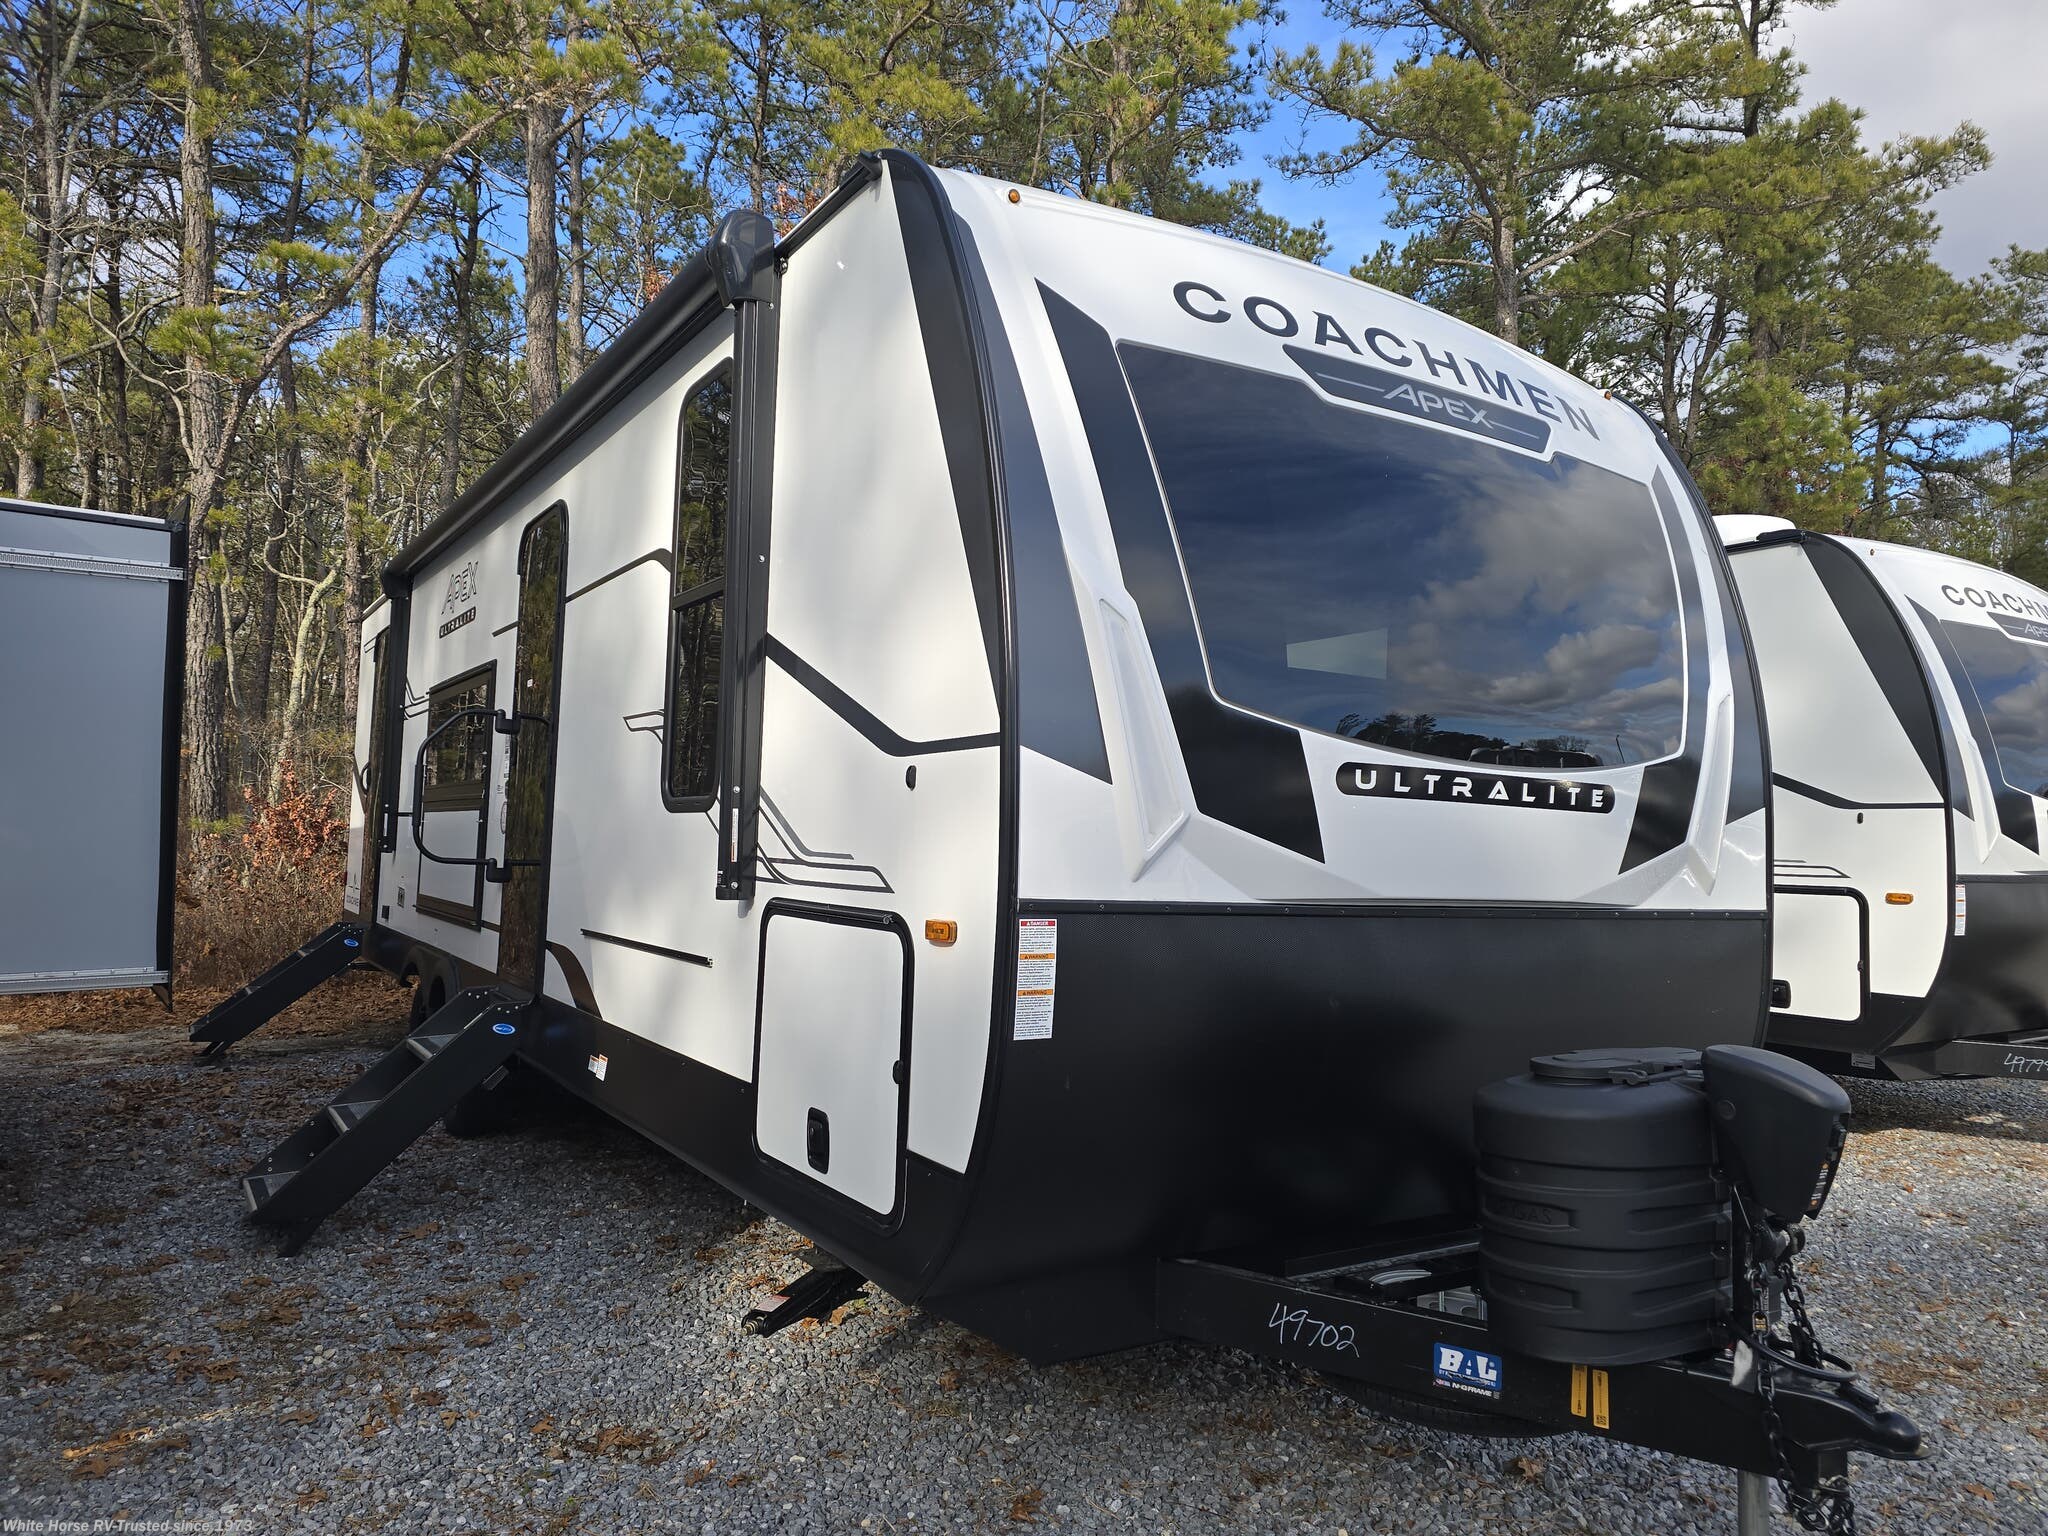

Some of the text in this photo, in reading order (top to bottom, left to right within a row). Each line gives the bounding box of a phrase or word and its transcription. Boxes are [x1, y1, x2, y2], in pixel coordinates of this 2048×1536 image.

[1173, 280, 1601, 441] COACHMEN
[1383, 383, 1494, 429] APEX
[441, 561, 479, 615] APEX
[440, 609, 475, 637] ULTRALITE
[1354, 768, 1605, 808] ULTRALITE
[1268, 1302, 1360, 1358] 49702
[1439, 1346, 1498, 1382] BAL
